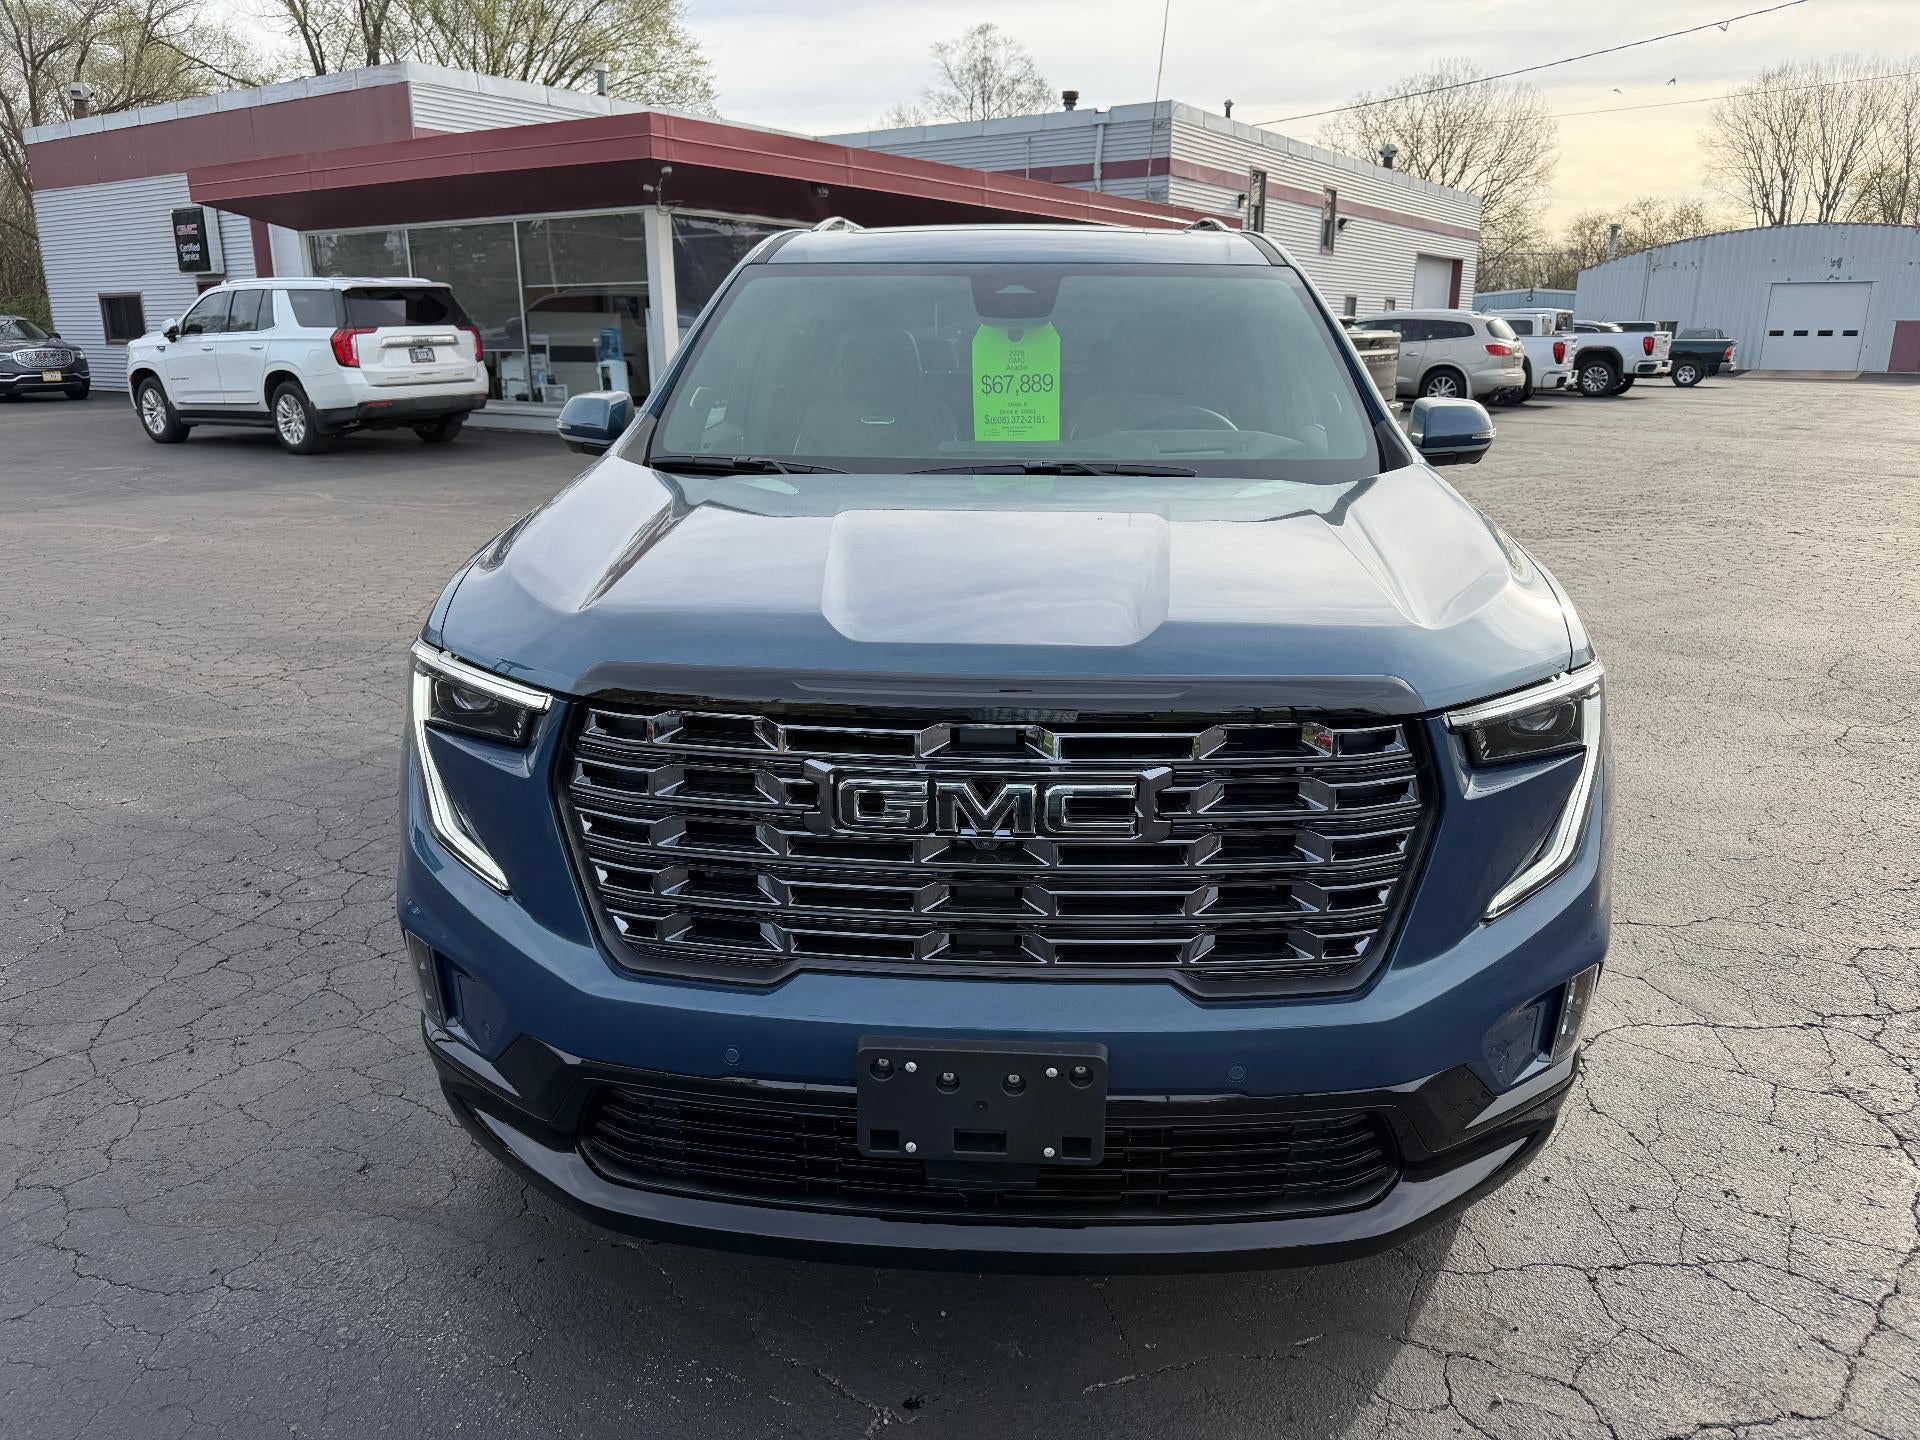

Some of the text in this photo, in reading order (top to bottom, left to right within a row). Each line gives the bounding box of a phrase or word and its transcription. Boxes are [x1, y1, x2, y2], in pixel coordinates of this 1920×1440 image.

[176, 223, 198, 235] GMC
[180, 242, 200, 252] Certified
[182, 252, 200, 261] Service
[981, 373, 1054, 396] $67,889
[836, 779, 1139, 837] GMC
